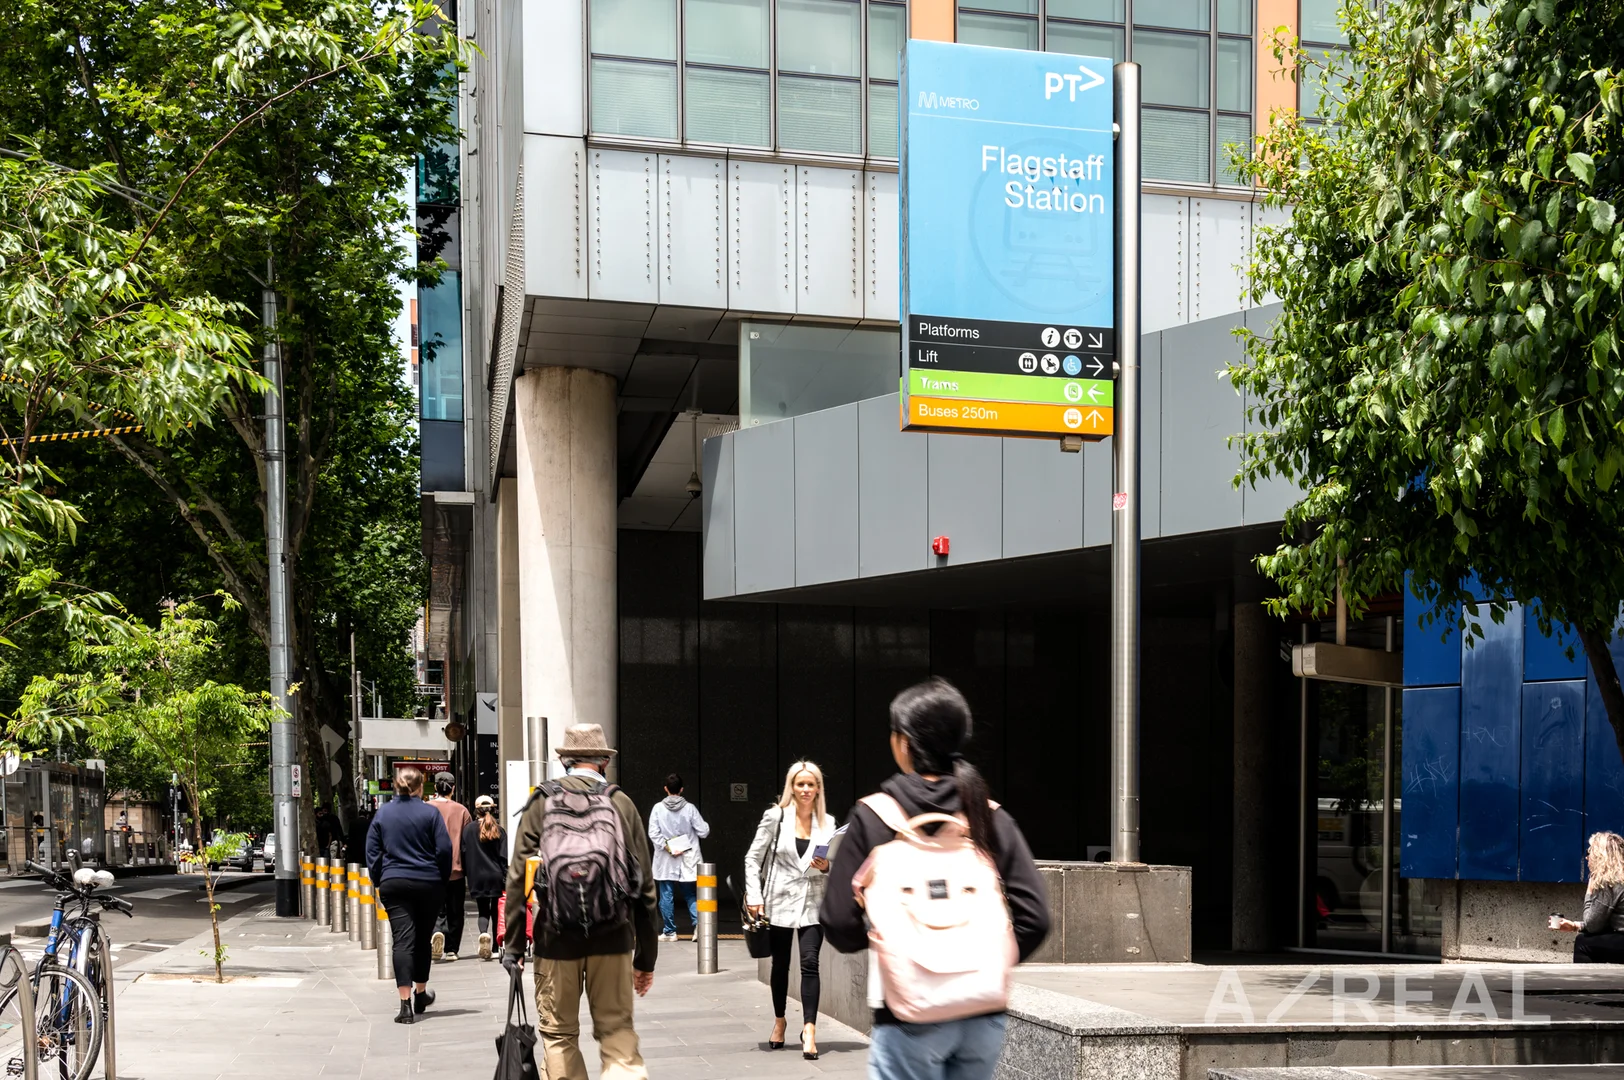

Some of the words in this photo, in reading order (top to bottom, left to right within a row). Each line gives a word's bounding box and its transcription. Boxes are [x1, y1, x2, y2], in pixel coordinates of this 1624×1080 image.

[939, 96, 980, 110] METRO
[982, 145, 1105, 183] Flagstaff
[1005, 181, 1105, 215] Station
[919, 322, 980, 339] Platforms
[918, 349, 939, 363] Lift
[921, 377, 959, 391] Trams
[918, 403, 959, 418] Buses
[962, 406, 998, 420] 250m
